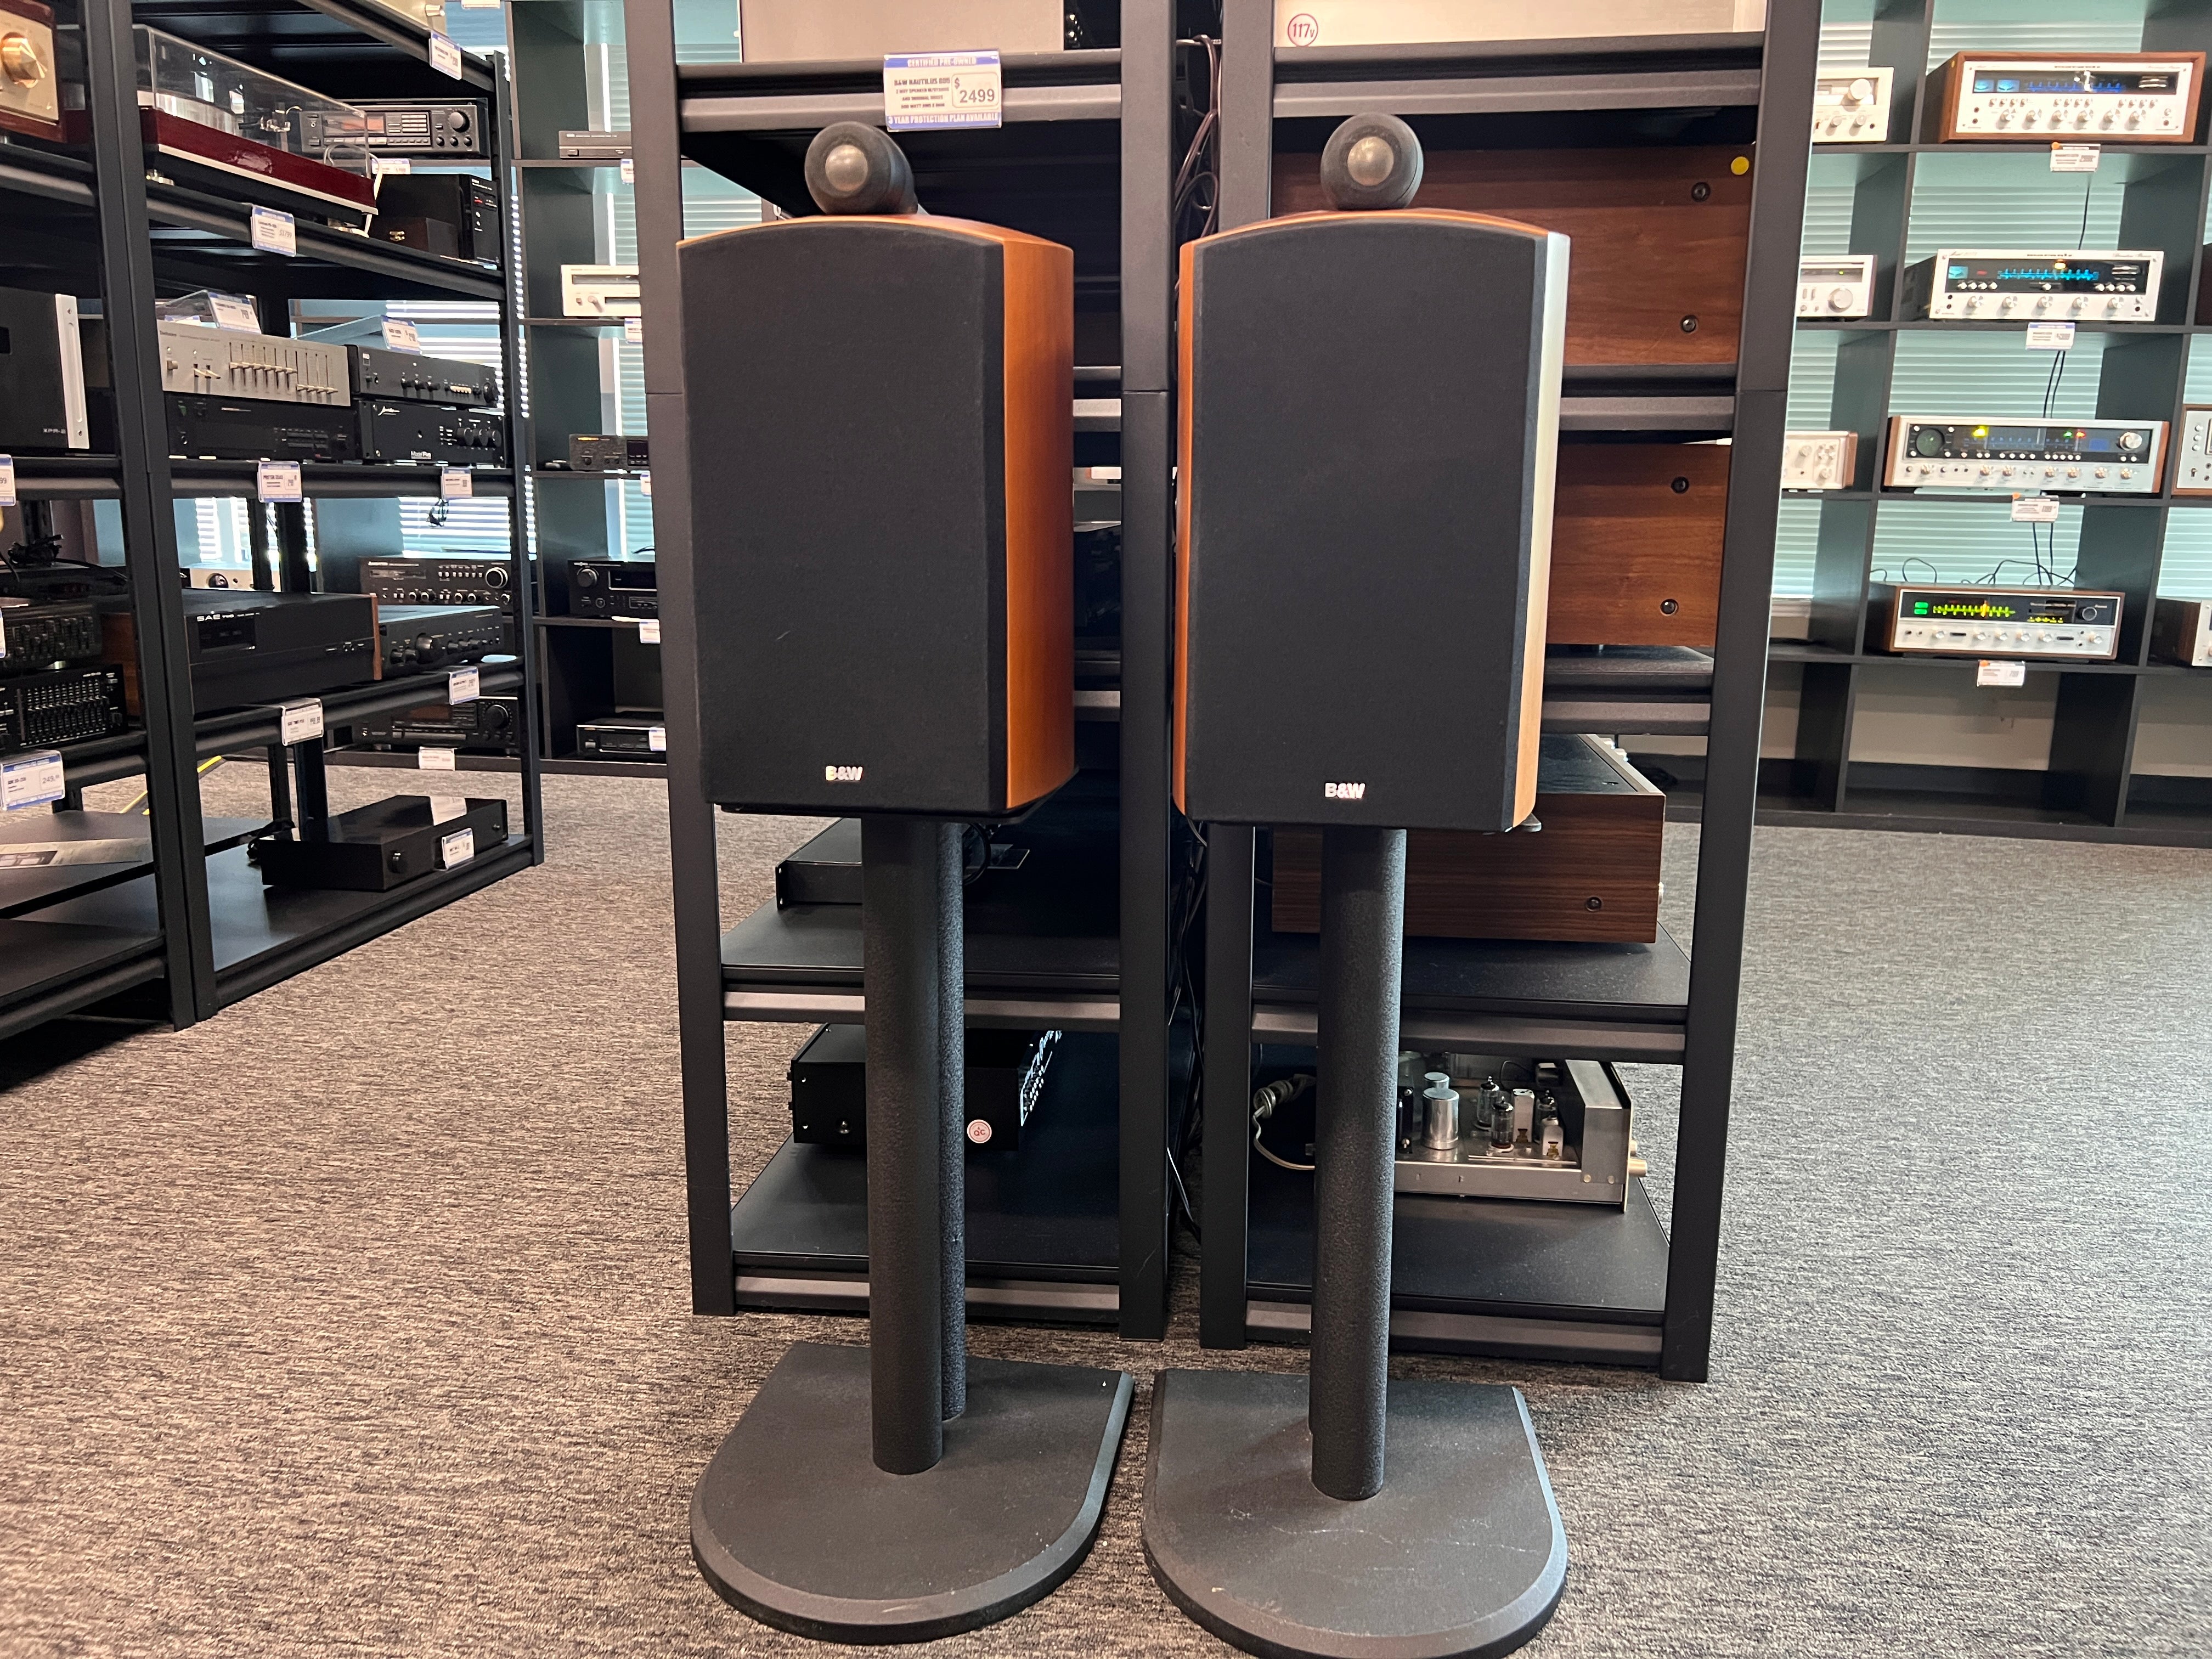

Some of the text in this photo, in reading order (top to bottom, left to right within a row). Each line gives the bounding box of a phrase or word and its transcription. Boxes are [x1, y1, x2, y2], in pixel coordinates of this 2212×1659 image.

[907, 57, 977, 67] CERTIFIED PRE-OWNED
[960, 89, 995, 103] 2499
[894, 116, 910, 124] YEAR
[910, 115, 949, 123] PROTECTION
[949, 114, 965, 122] PLAN
[966, 112, 998, 121] AVAILABLE
[197, 614, 221, 622] SAE
[825, 765, 863, 781] B&W
[1325, 782, 1365, 799] B&W
